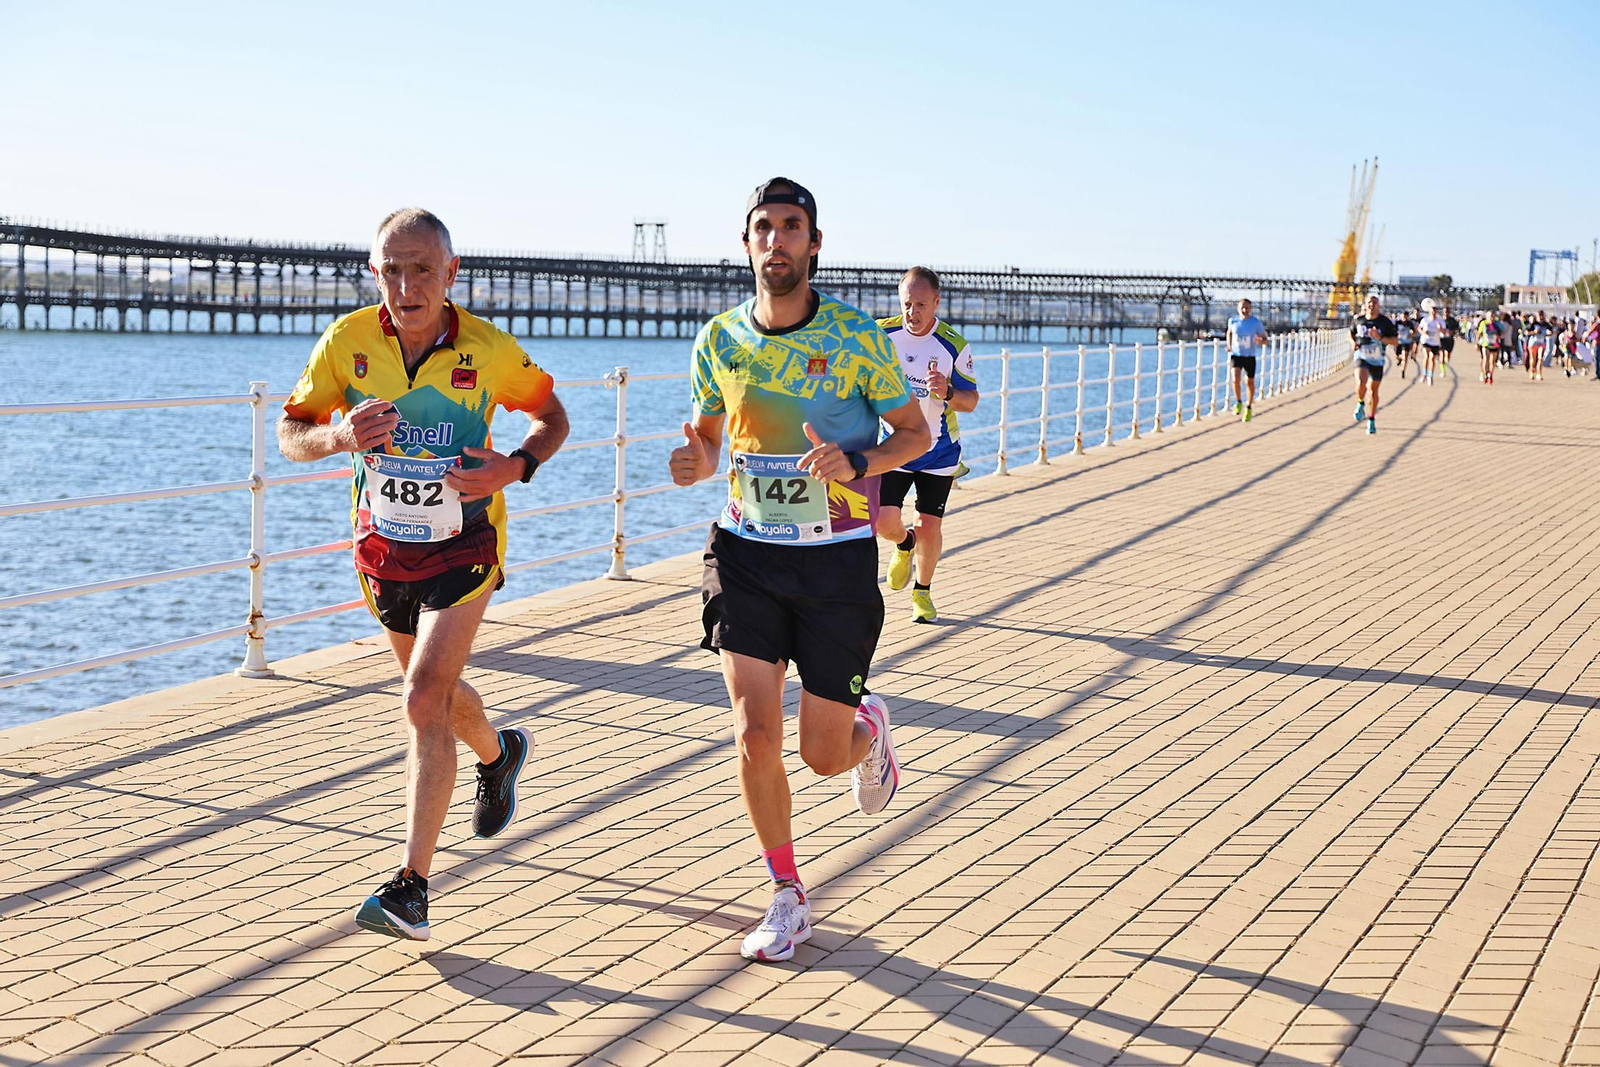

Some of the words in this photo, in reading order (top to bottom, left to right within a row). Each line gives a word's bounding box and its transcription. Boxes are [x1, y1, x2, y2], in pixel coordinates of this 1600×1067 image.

[392, 420, 453, 446] Snell
[380, 478, 444, 507] 482
[749, 477, 810, 505] 142
[381, 519, 425, 535] Wayalia
[753, 523, 793, 536] Wayalia
